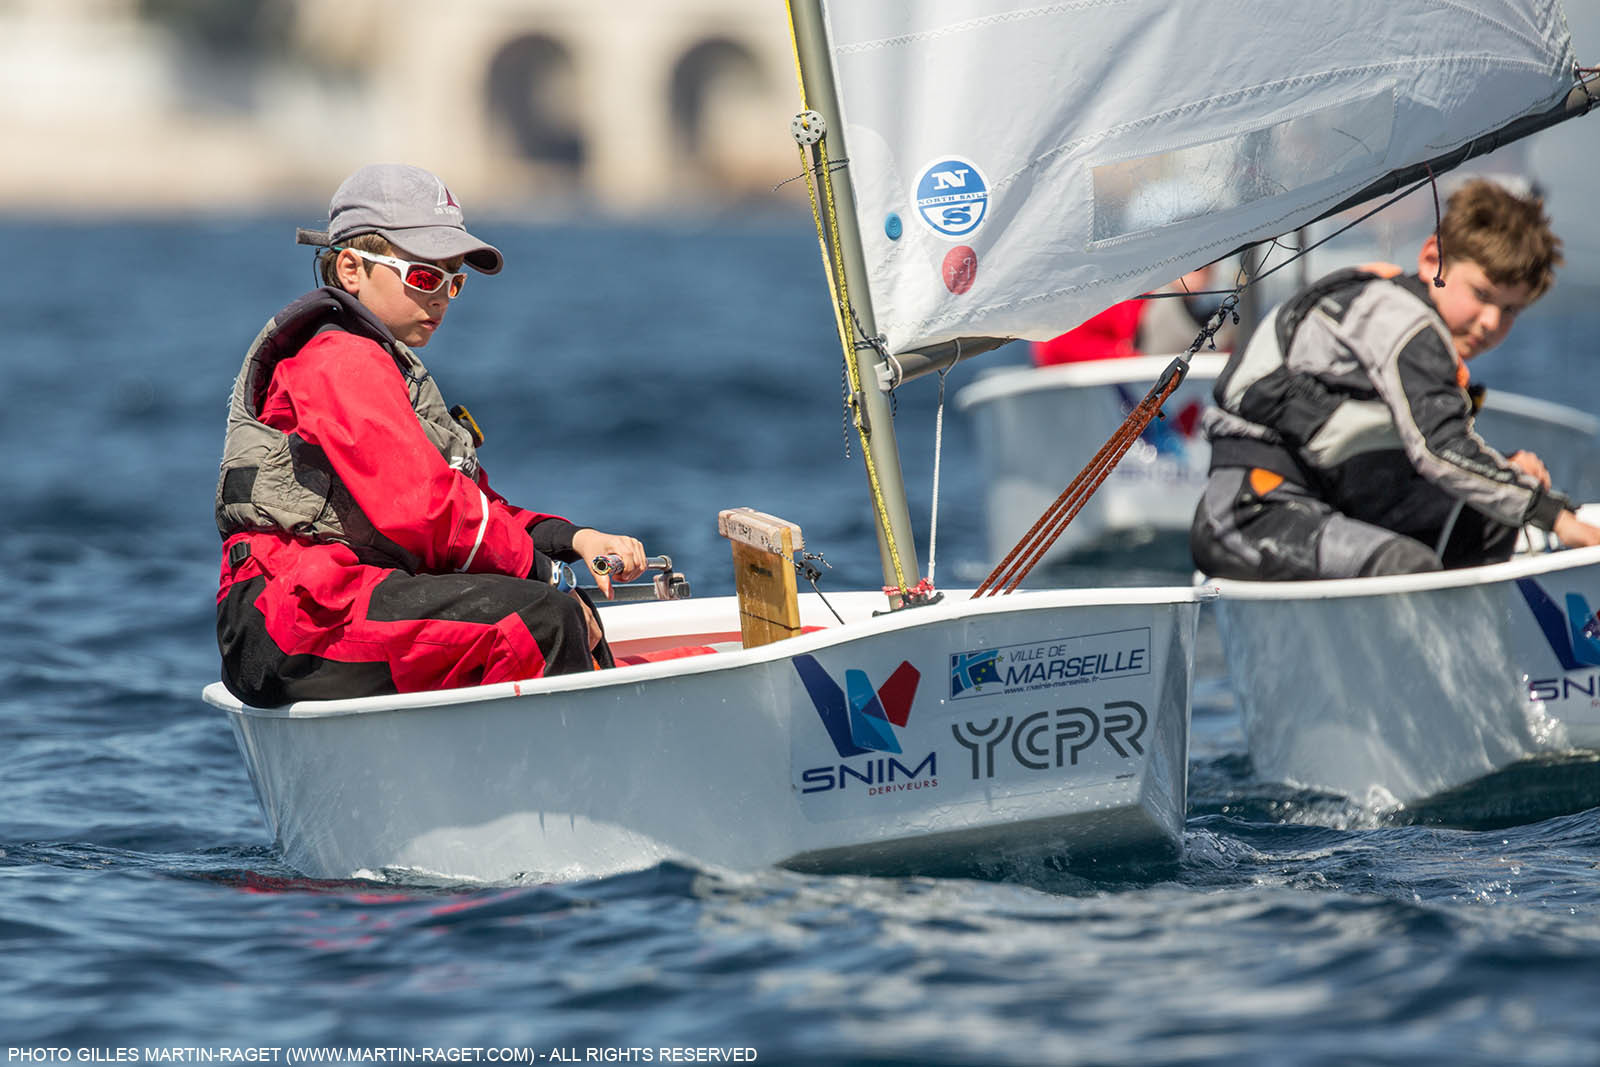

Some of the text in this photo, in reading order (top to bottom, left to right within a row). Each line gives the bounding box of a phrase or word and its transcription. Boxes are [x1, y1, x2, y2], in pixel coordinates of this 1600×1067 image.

[931, 169, 969, 190] N
[919, 196, 955, 205] NORTH
[942, 205, 972, 226] S
[1009, 644, 1068, 663] VILLE DE
[1005, 648, 1146, 686] MARSEILLE
[951, 700, 1148, 780] YCPR
[801, 751, 937, 794] SNIM
[868, 779, 939, 796] DERIVEURS
